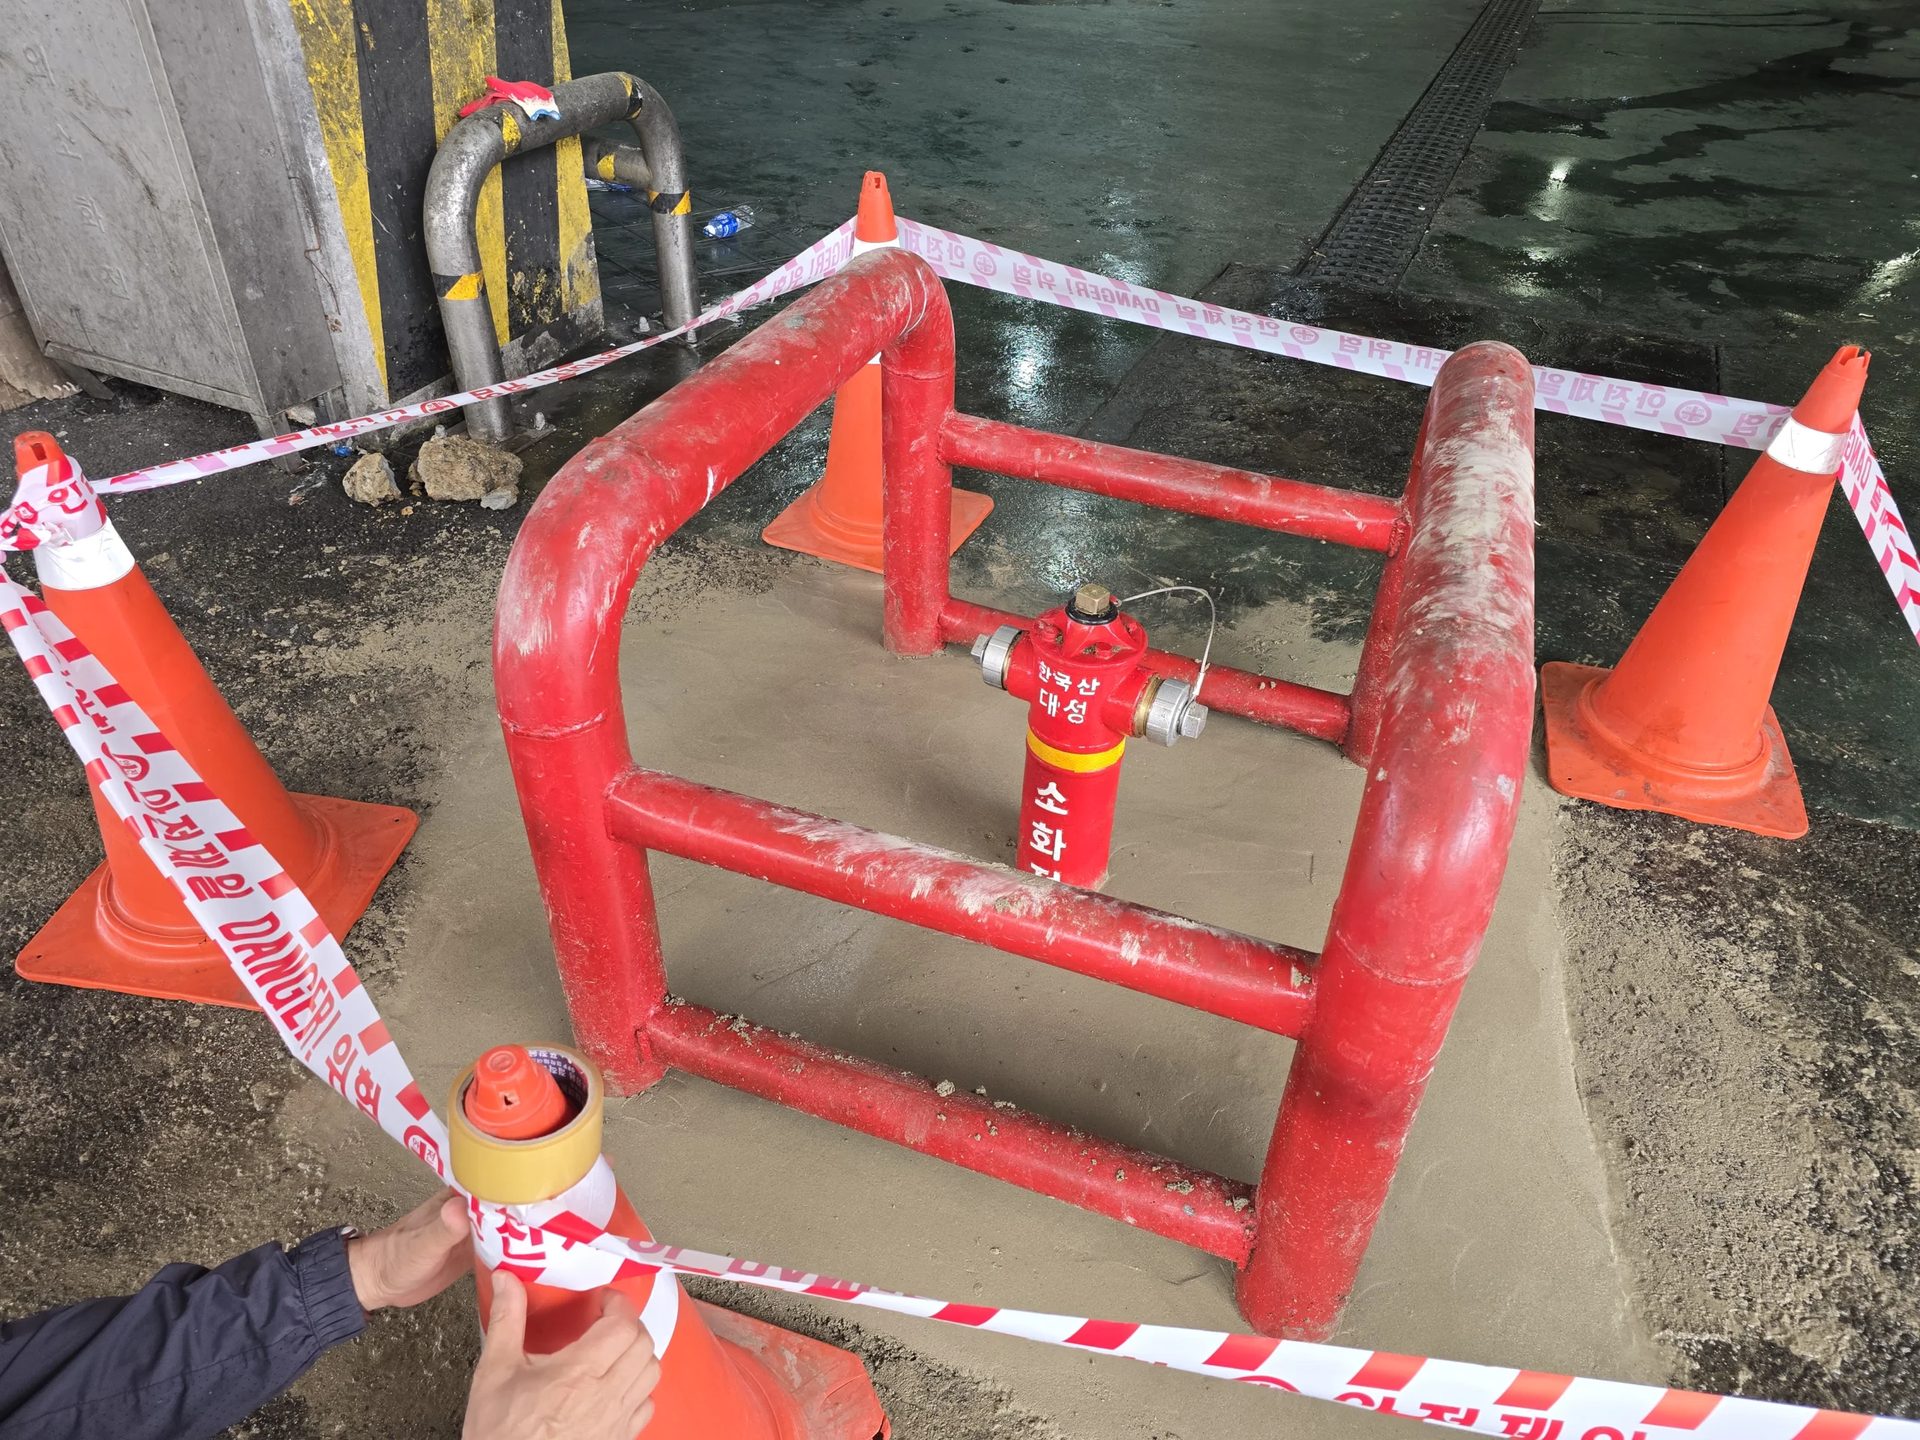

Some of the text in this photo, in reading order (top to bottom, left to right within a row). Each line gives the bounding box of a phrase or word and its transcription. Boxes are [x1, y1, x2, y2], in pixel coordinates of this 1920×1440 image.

[1038, 660, 1100, 696] 한국산
[1038, 688, 1087, 725] 대성
[124, 780, 255, 901] 안전제일
[325, 1033, 382, 1128] 위험
